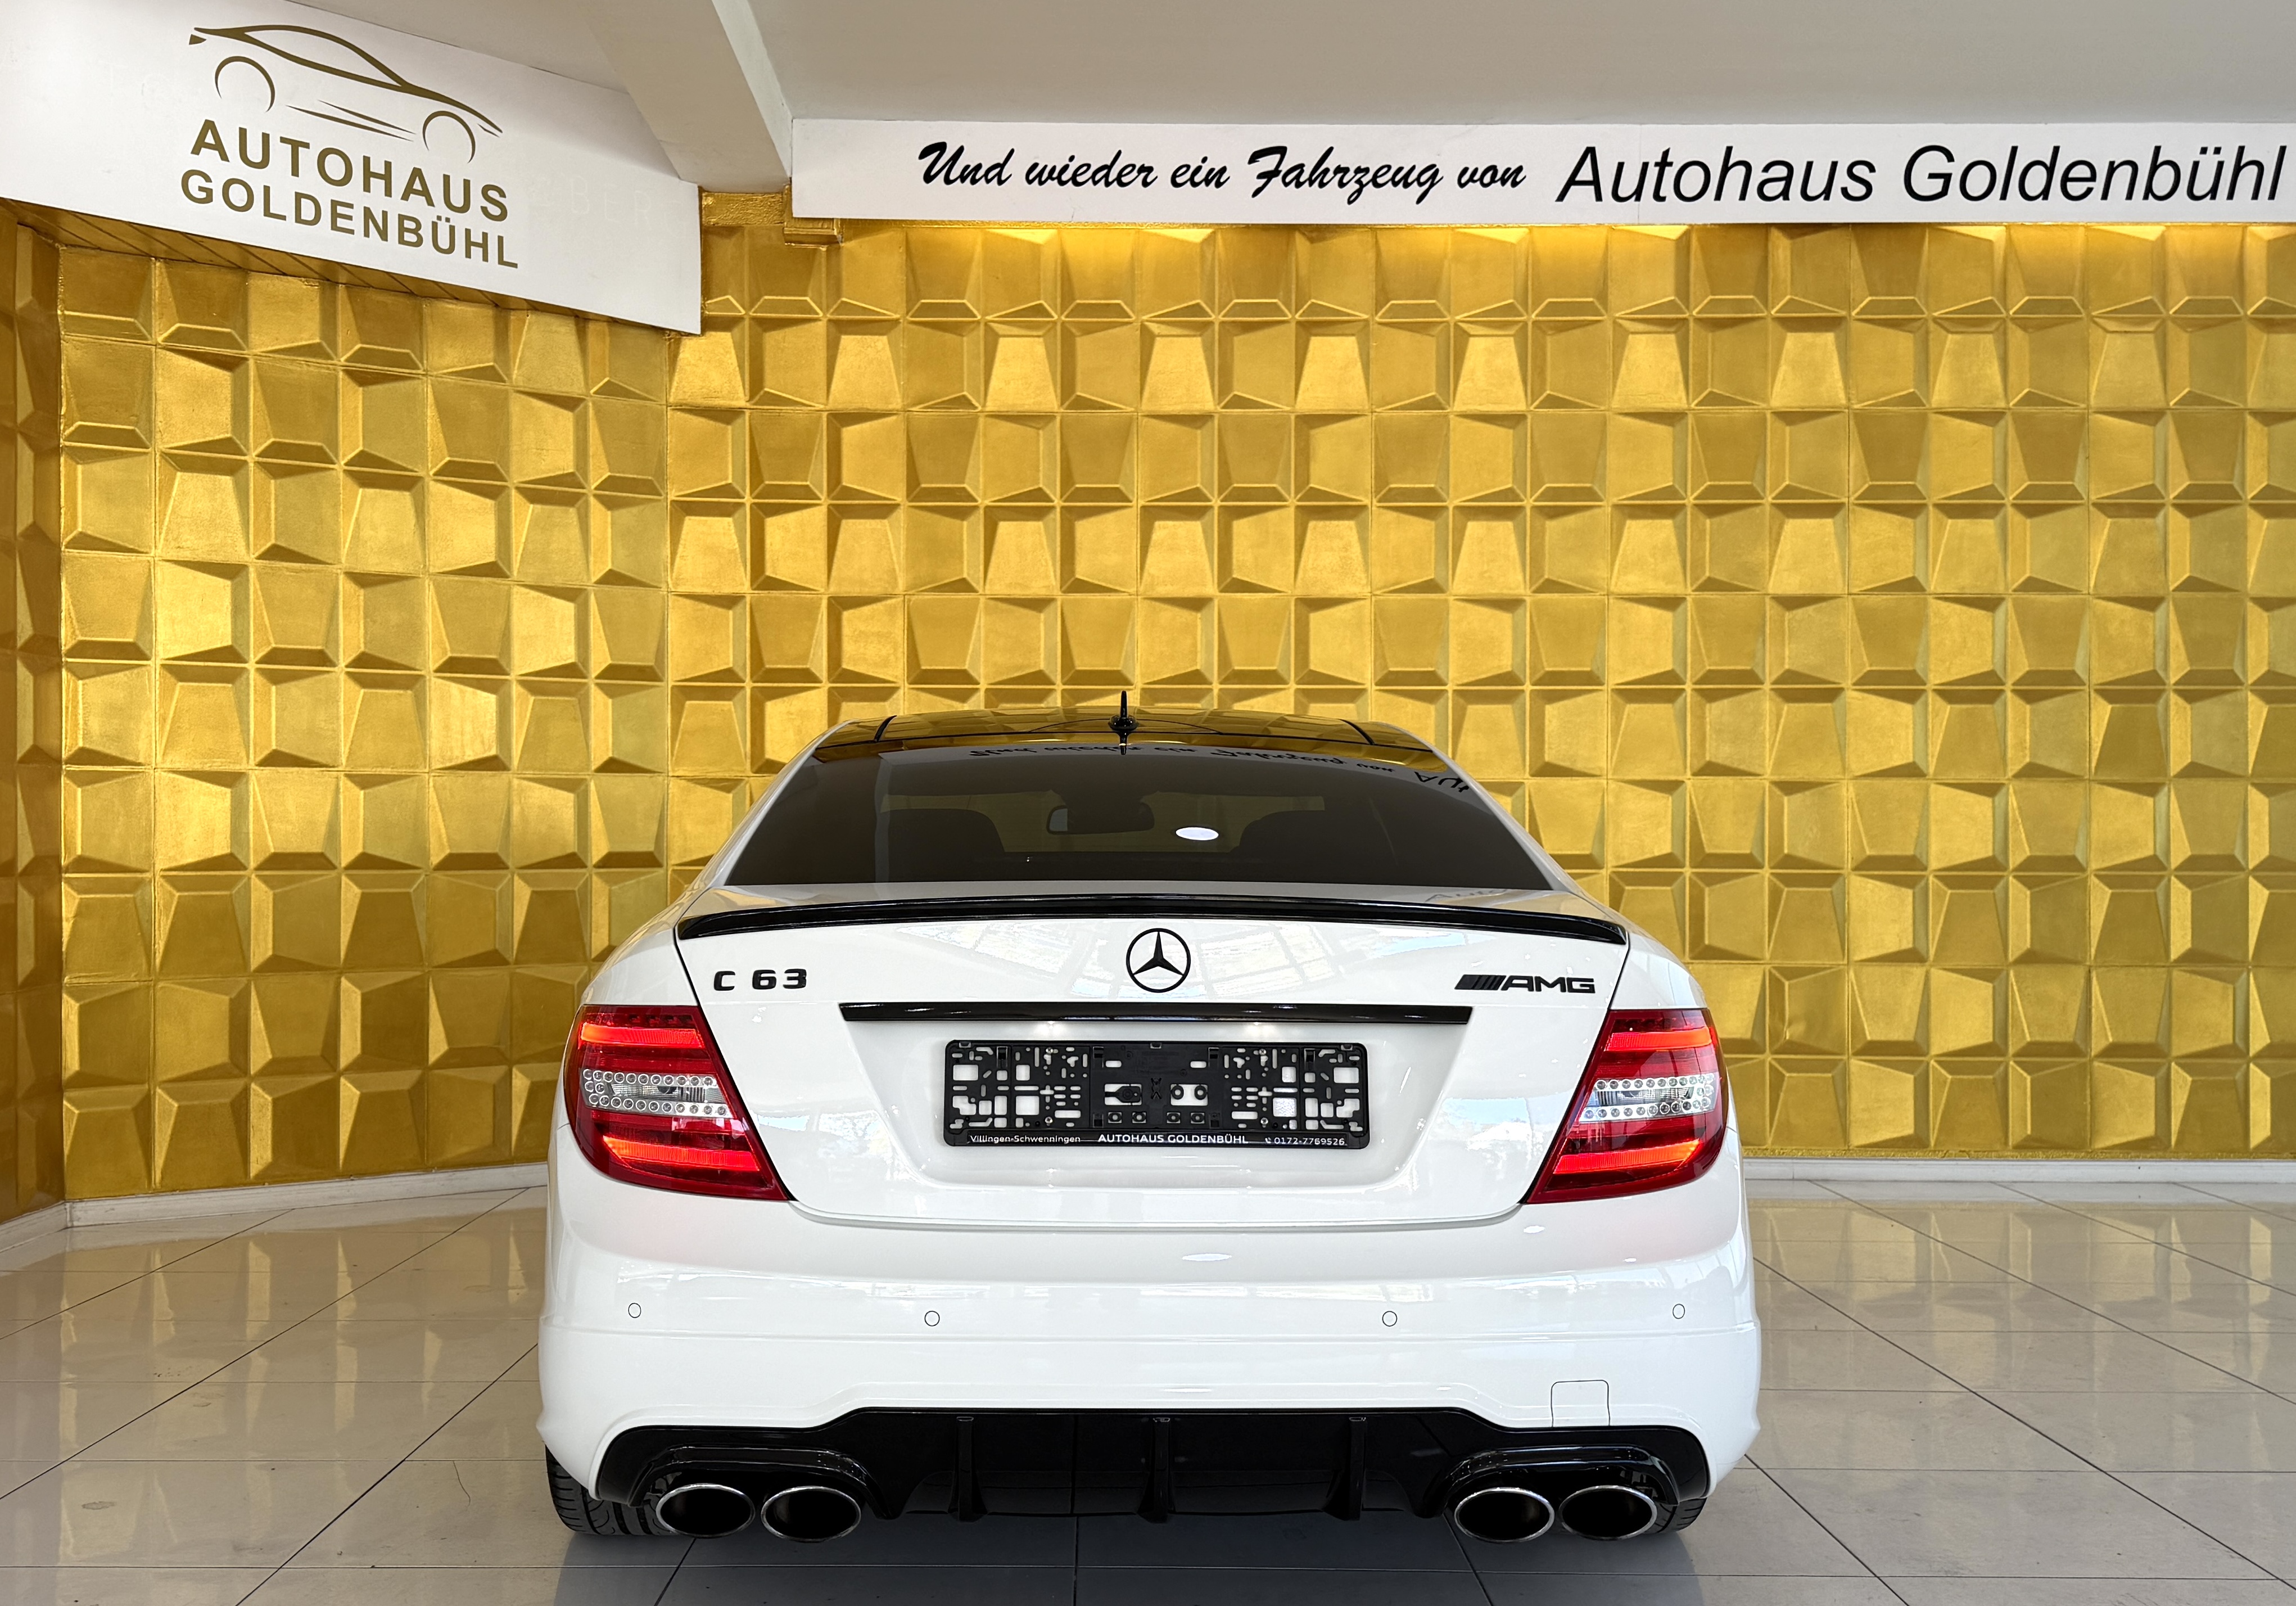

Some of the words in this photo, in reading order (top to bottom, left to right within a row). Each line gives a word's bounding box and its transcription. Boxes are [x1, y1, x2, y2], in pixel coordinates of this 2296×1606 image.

[190, 119, 508, 222] AUTOHAUS
[918, 141, 1015, 186] Und
[1025, 149, 1158, 188] wieder
[1170, 156, 1231, 189] ein
[1248, 146, 1444, 205] Fahrzeug
[1457, 164, 1526, 189] von
[1554, 146, 1877, 203] Autohaus
[1904, 145, 2287, 202] Goldenbühl
[181, 169, 518, 269] GOLDENBÜHL
[713, 971, 736, 991] C
[752, 968, 807, 990] 63
[1500, 975, 1596, 994] AMG
[970, 1135, 1081, 1144] Villingen-Schwenningen
[1097, 1134, 1165, 1143] AUTOHAUS
[1168, 1133, 1249, 1144] GOLDENBÜHL
